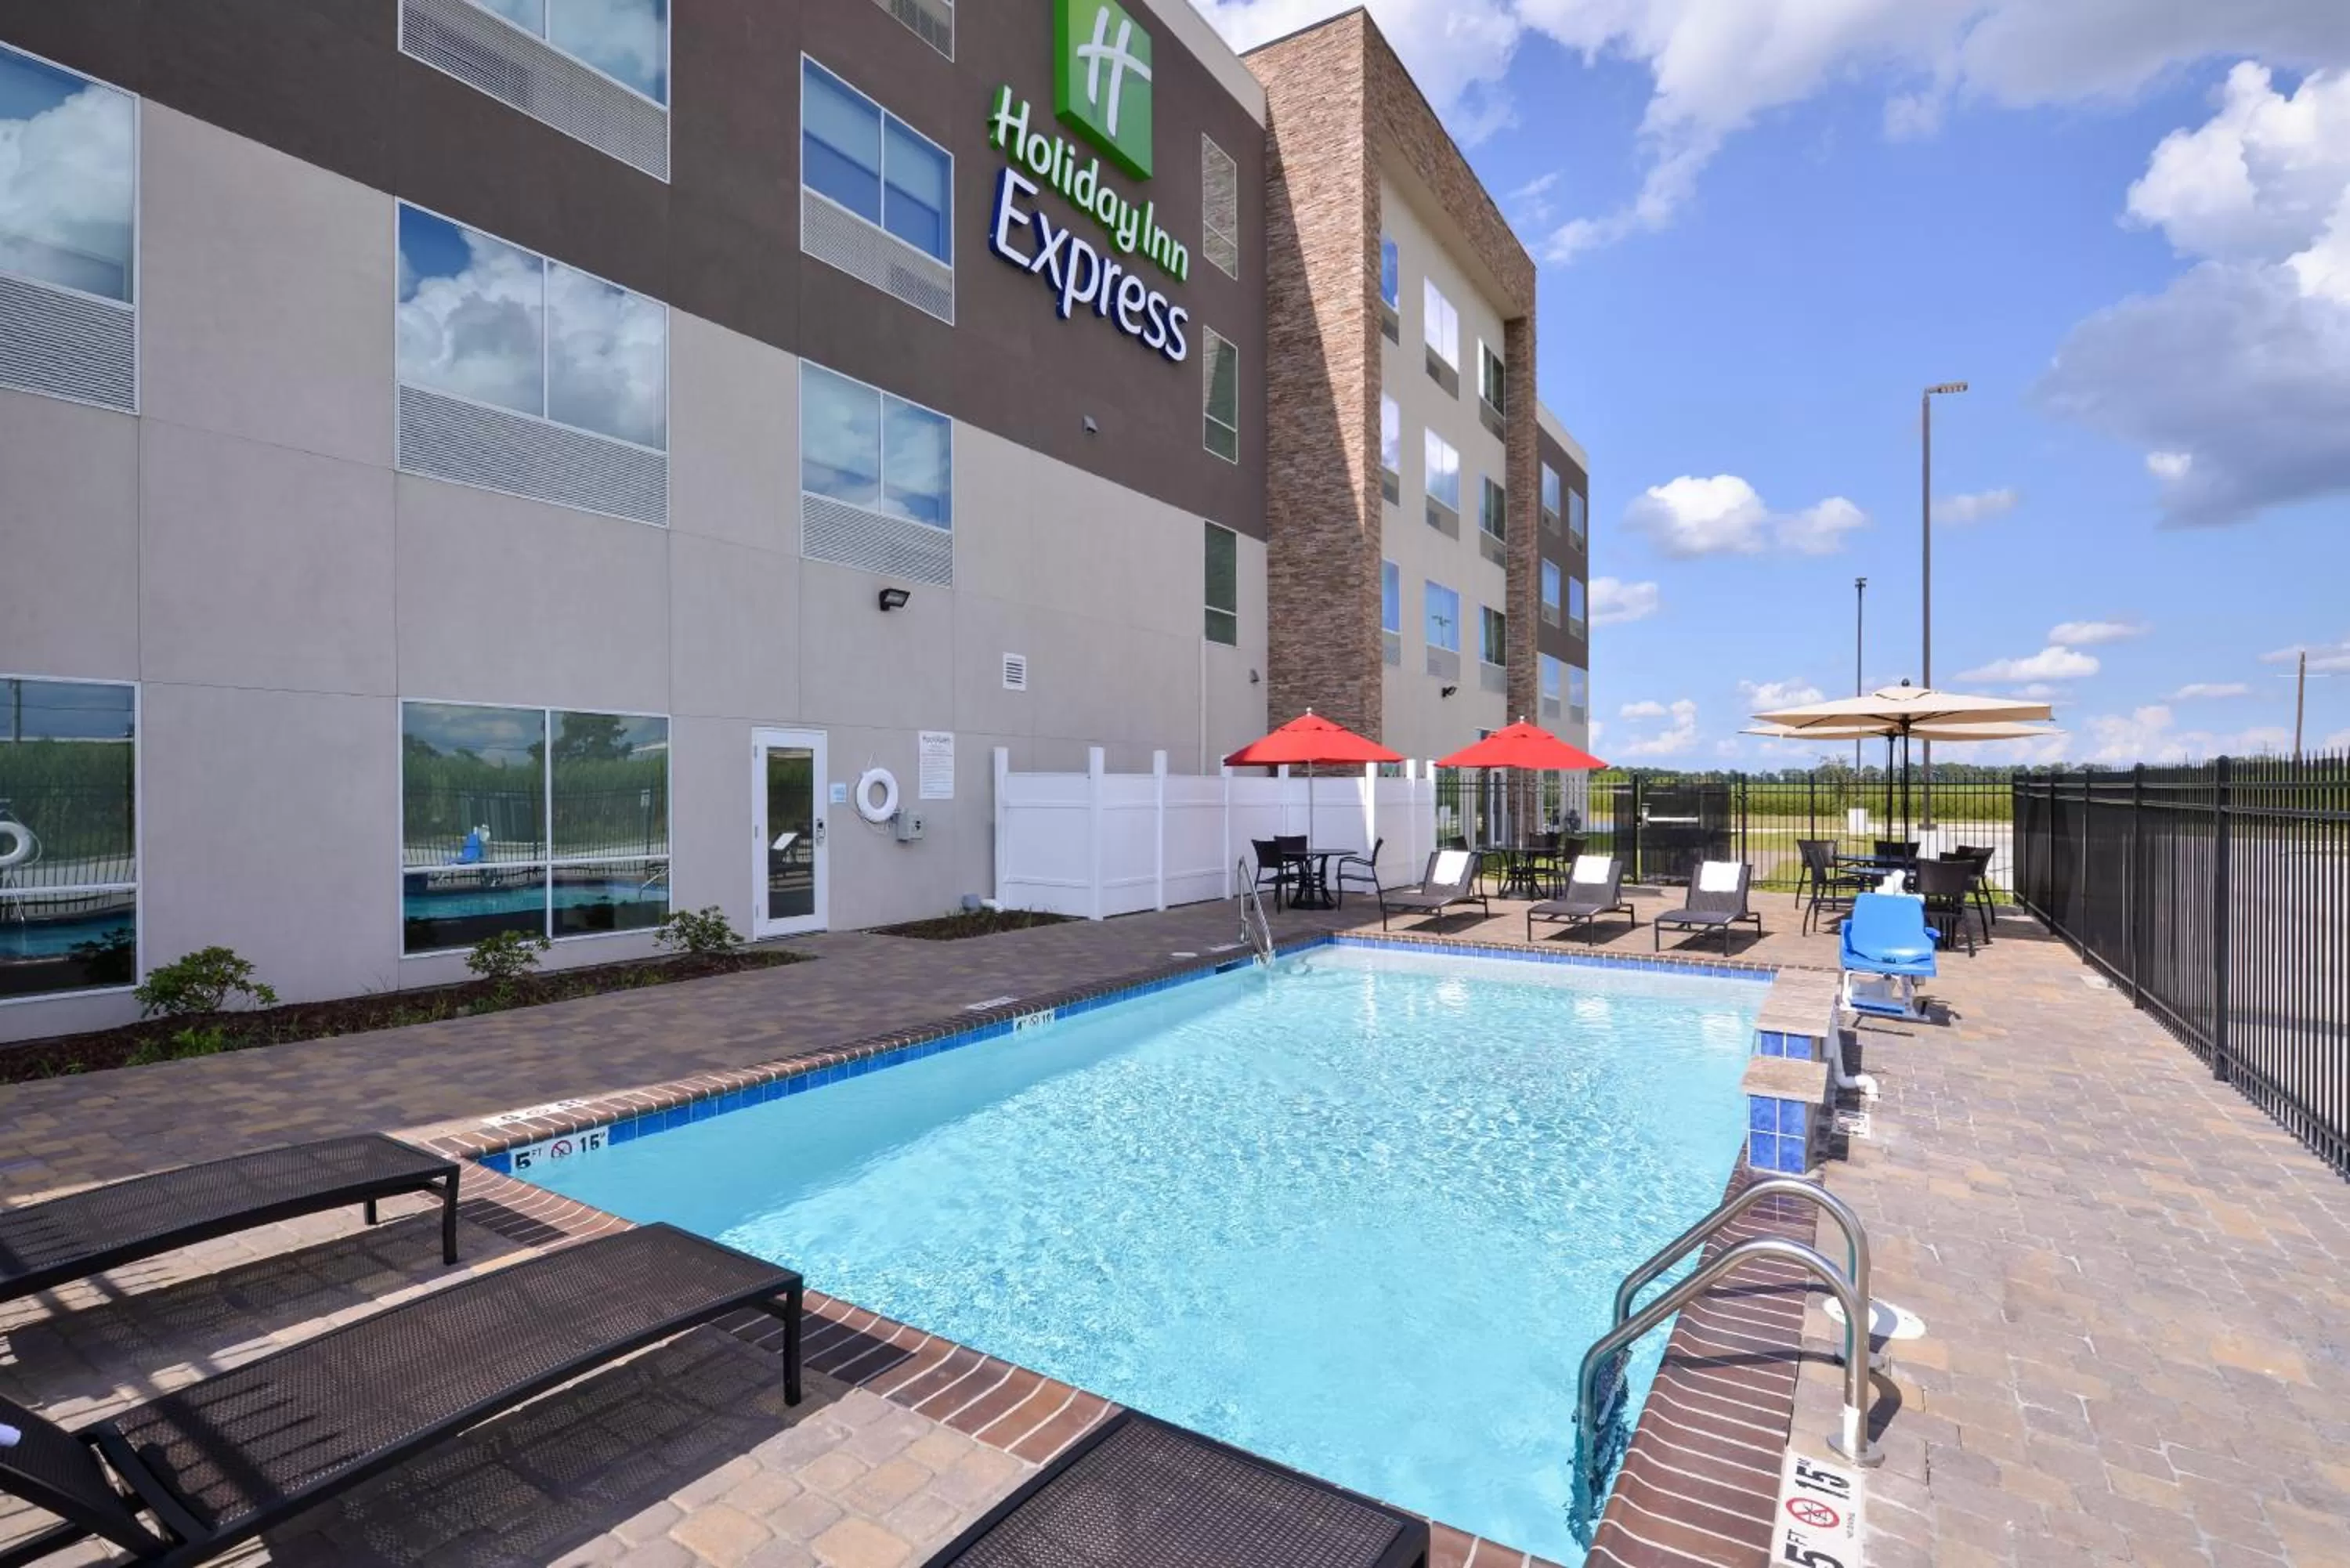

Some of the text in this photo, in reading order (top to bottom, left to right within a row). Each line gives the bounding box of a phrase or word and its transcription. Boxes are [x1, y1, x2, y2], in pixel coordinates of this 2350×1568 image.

[988, 84, 1189, 282] Holiday Inn
[989, 166, 1189, 363] Express
